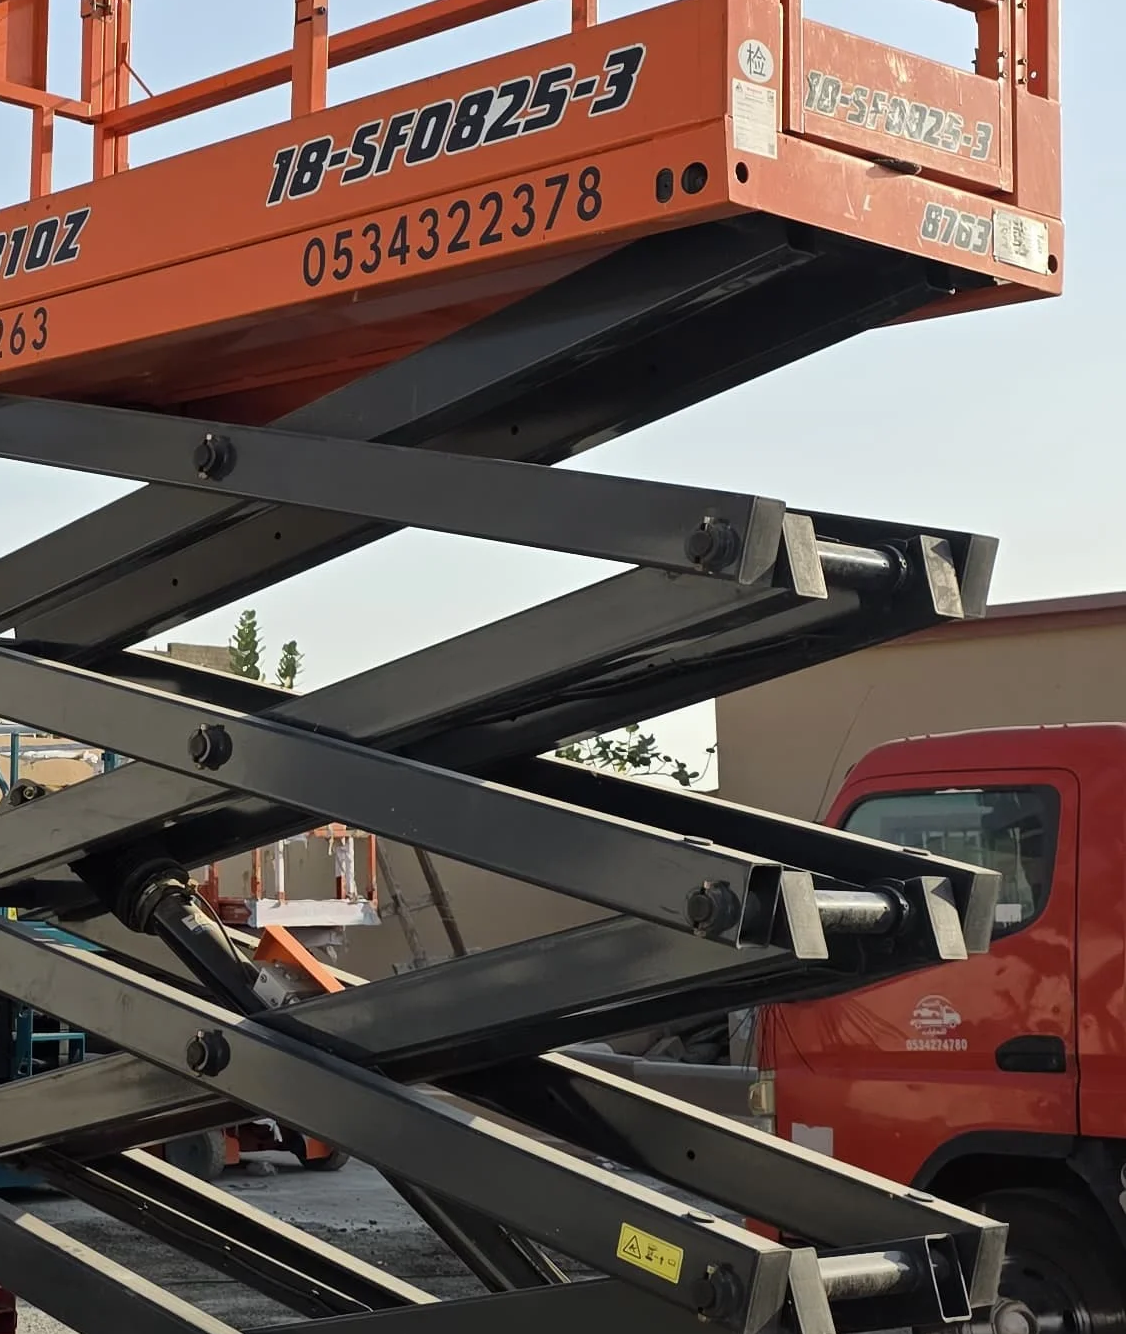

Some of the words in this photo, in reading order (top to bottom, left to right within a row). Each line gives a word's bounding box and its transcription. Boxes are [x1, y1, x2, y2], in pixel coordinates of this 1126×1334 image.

[266, 43, 646, 208] 18-SF0825-3
[302, 166, 602, 287] 0534322378
[920, 201, 992, 256] 8763
